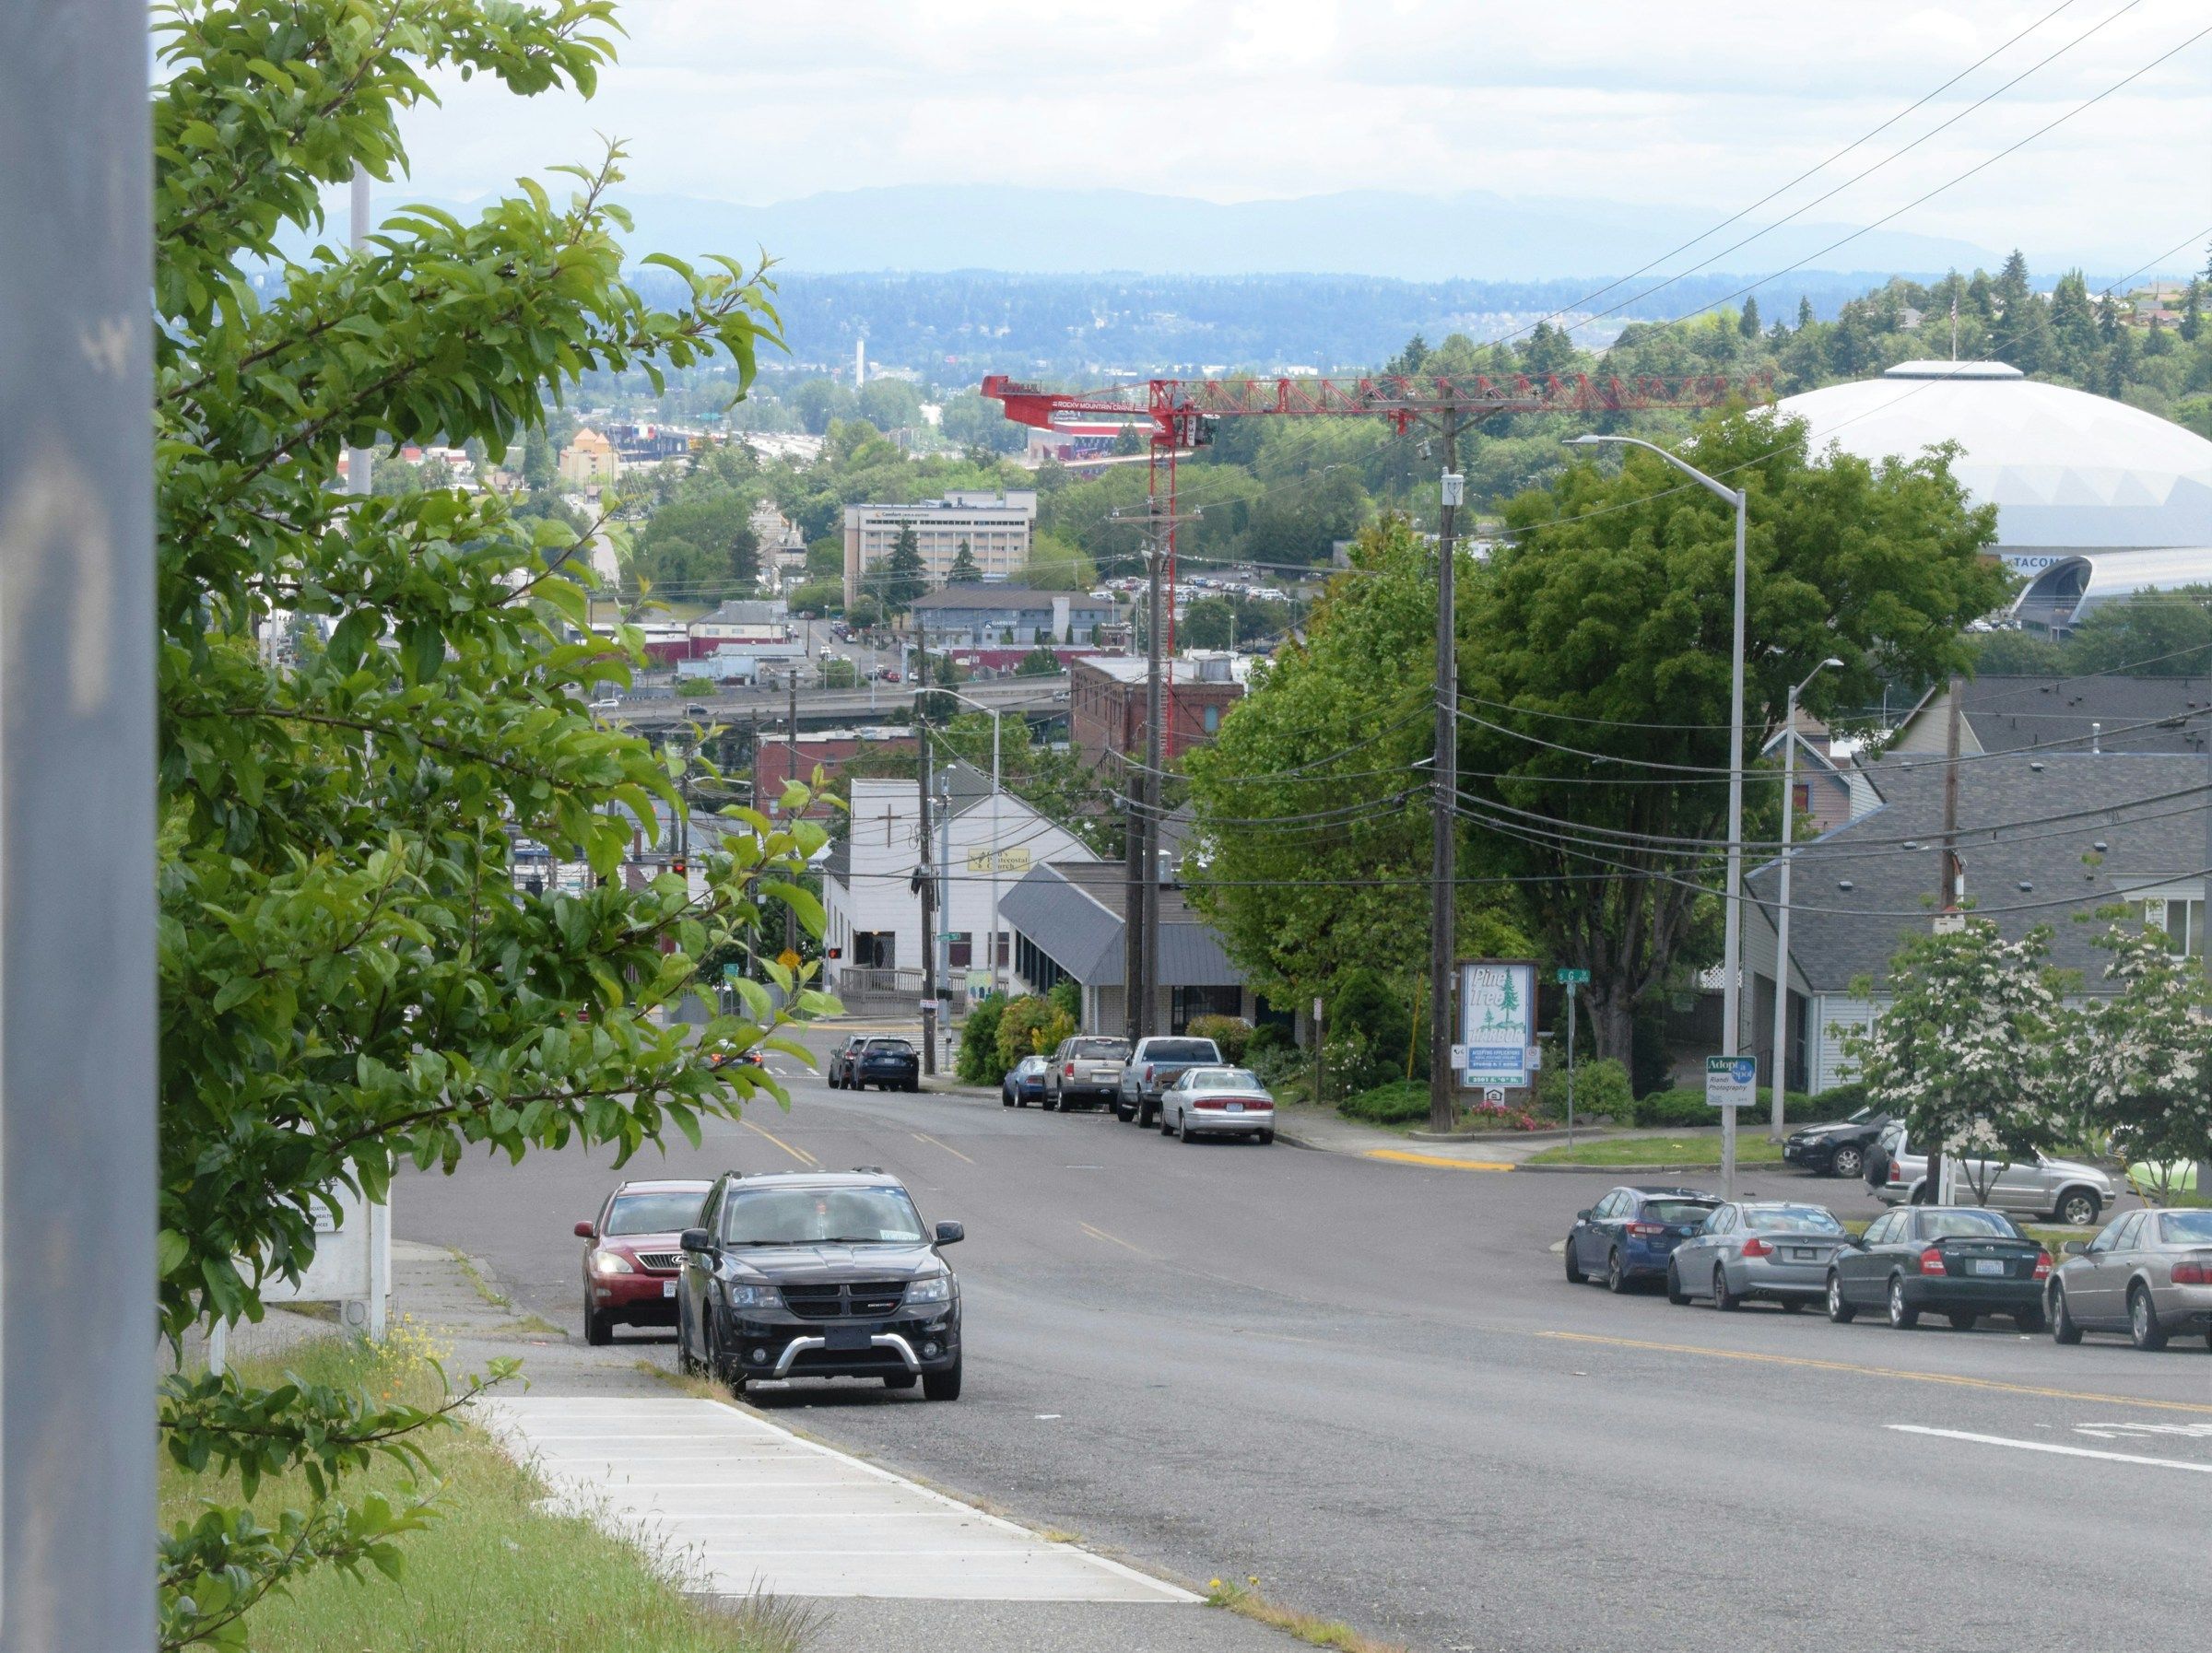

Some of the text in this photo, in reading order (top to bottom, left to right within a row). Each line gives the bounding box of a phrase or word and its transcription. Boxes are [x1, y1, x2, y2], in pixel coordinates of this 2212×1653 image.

[1079, 402, 1112, 411] MOUNTAIN
[1112, 404, 1135, 412] CRANE
[1471, 967, 1505, 988] Pine
[1568, 970, 1574, 981] G
[1470, 988, 1506, 1007] Tree
[1468, 1027, 1526, 1043] HARBOR
[1708, 1060, 1738, 1072] Adopt
[1732, 1069, 1752, 1080] Spot
